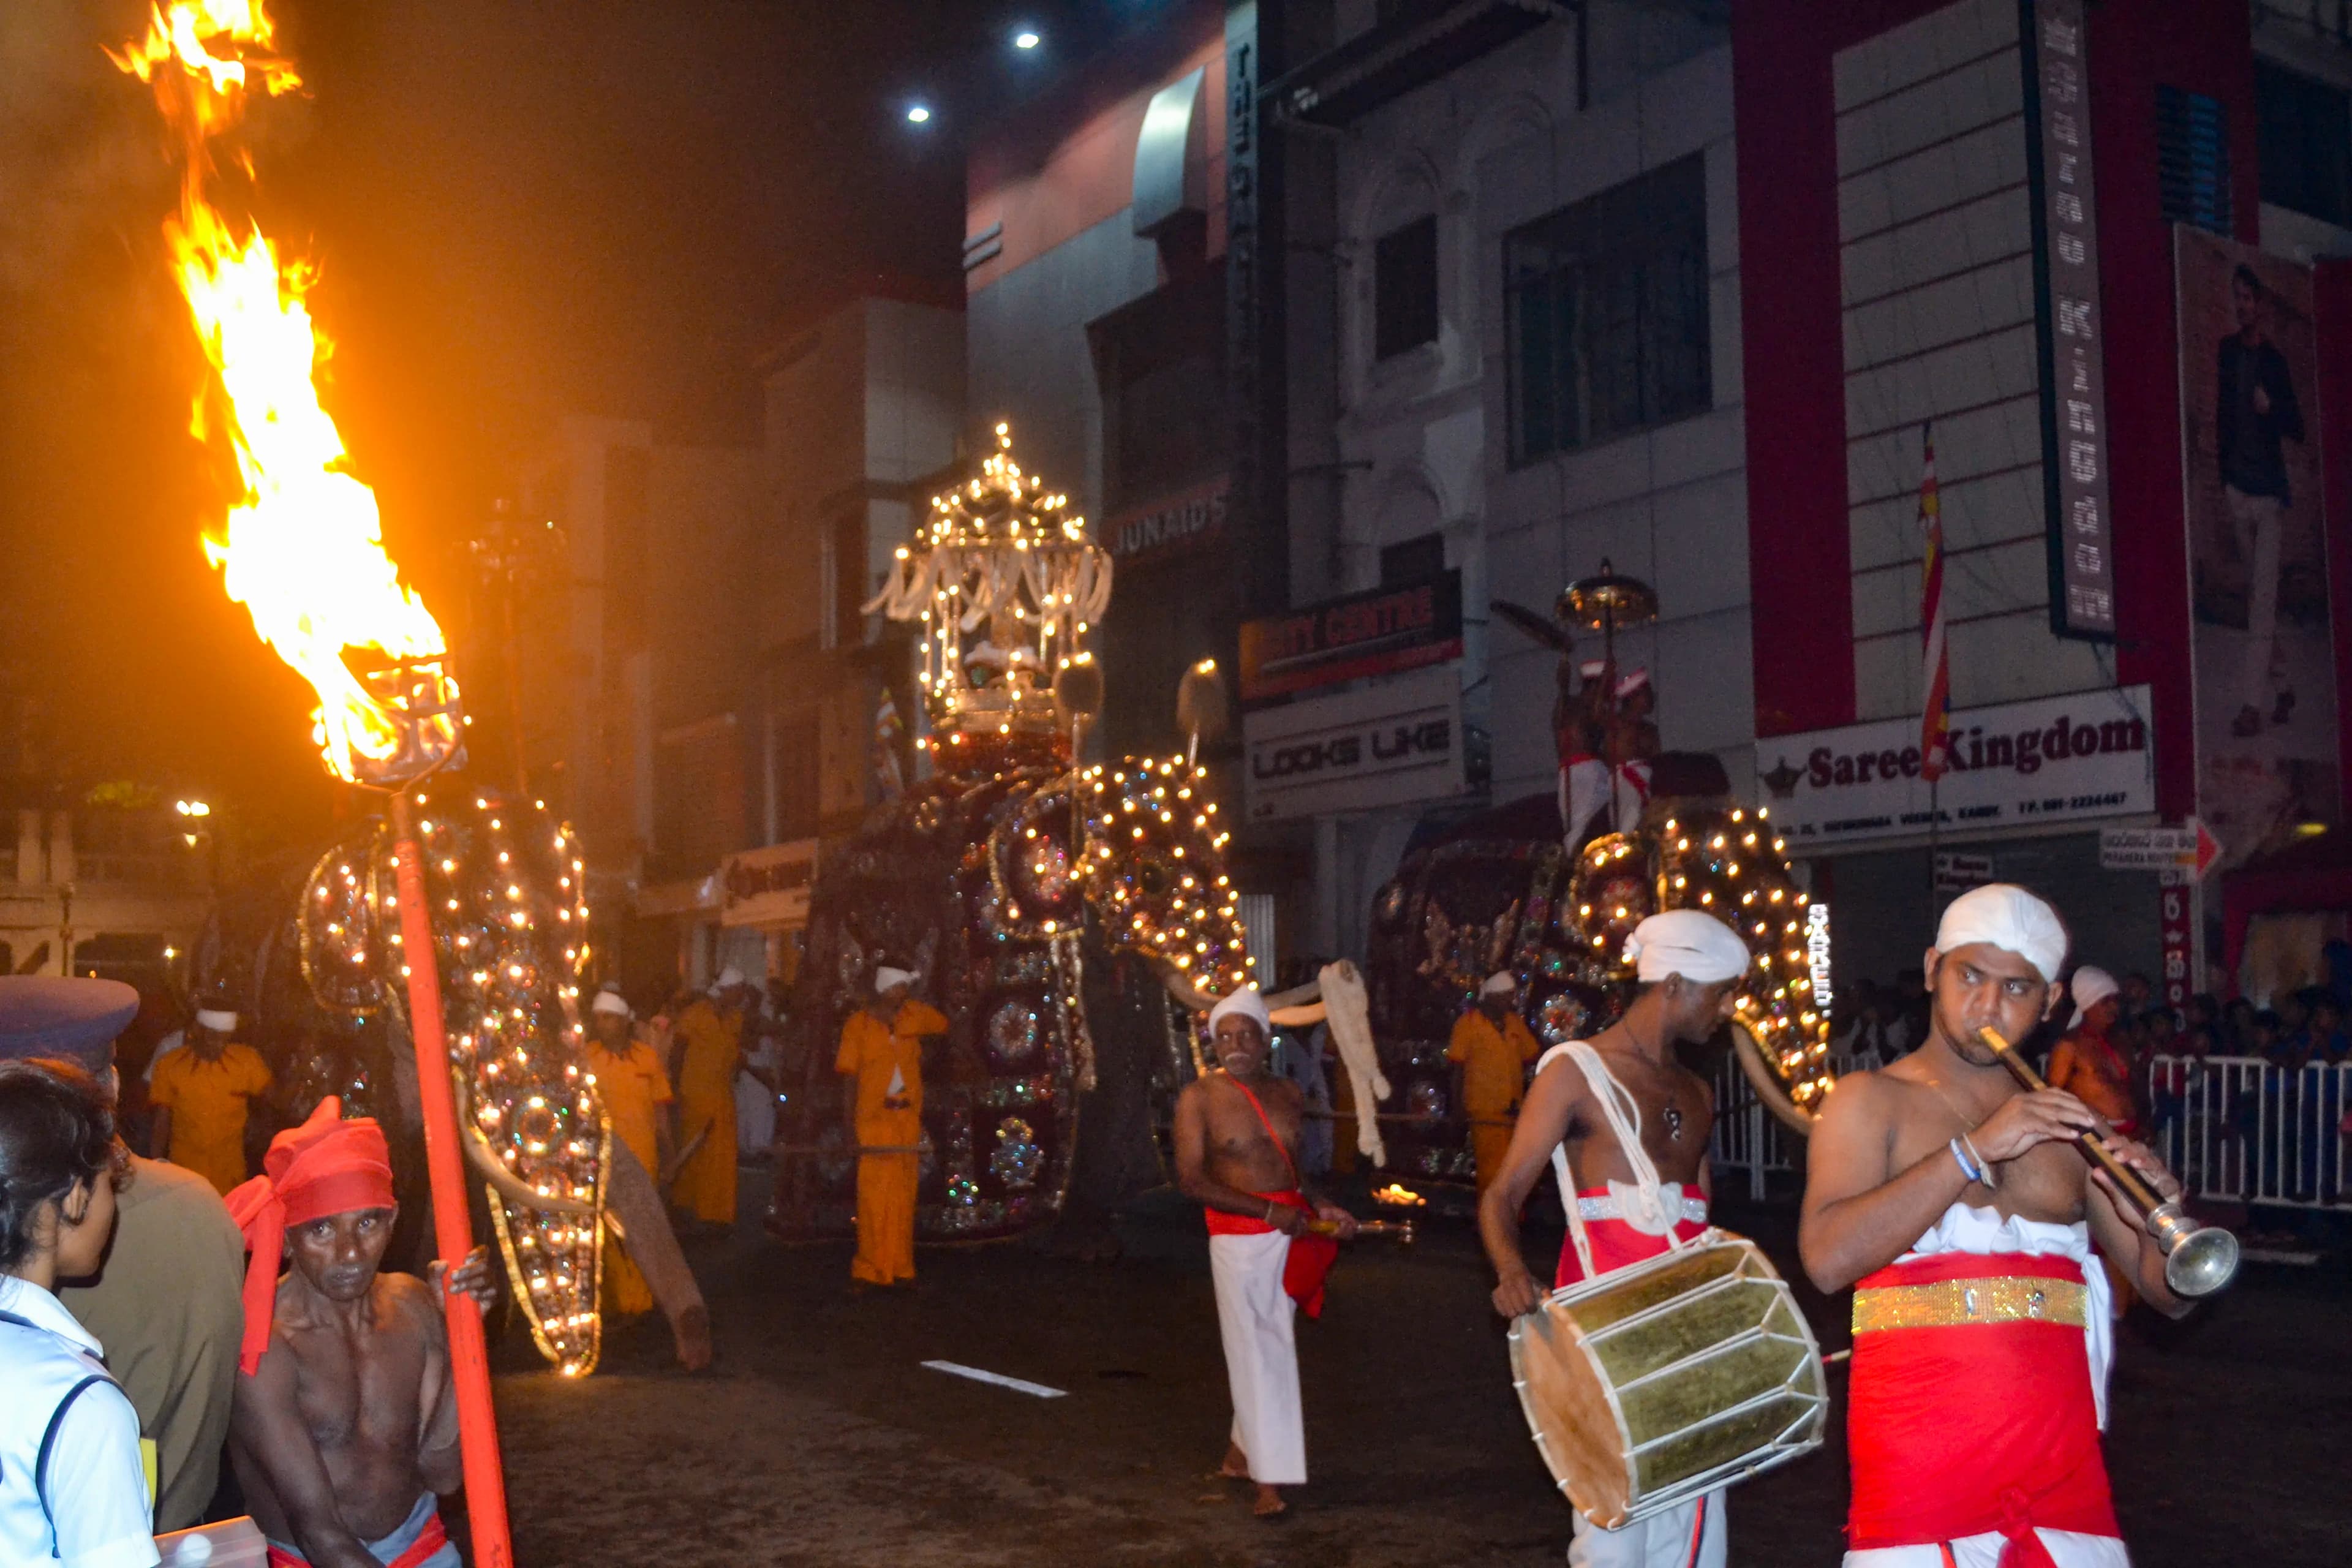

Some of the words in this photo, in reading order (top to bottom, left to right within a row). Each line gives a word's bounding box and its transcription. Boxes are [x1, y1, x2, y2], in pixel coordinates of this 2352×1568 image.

[1327, 587, 1432, 645] CENTRE
[1253, 736, 1360, 778] LOOKS
[1371, 719, 1450, 760] LIKE
[1808, 747, 1922, 788] Saree
[1944, 715, 2146, 774] Kingdom
